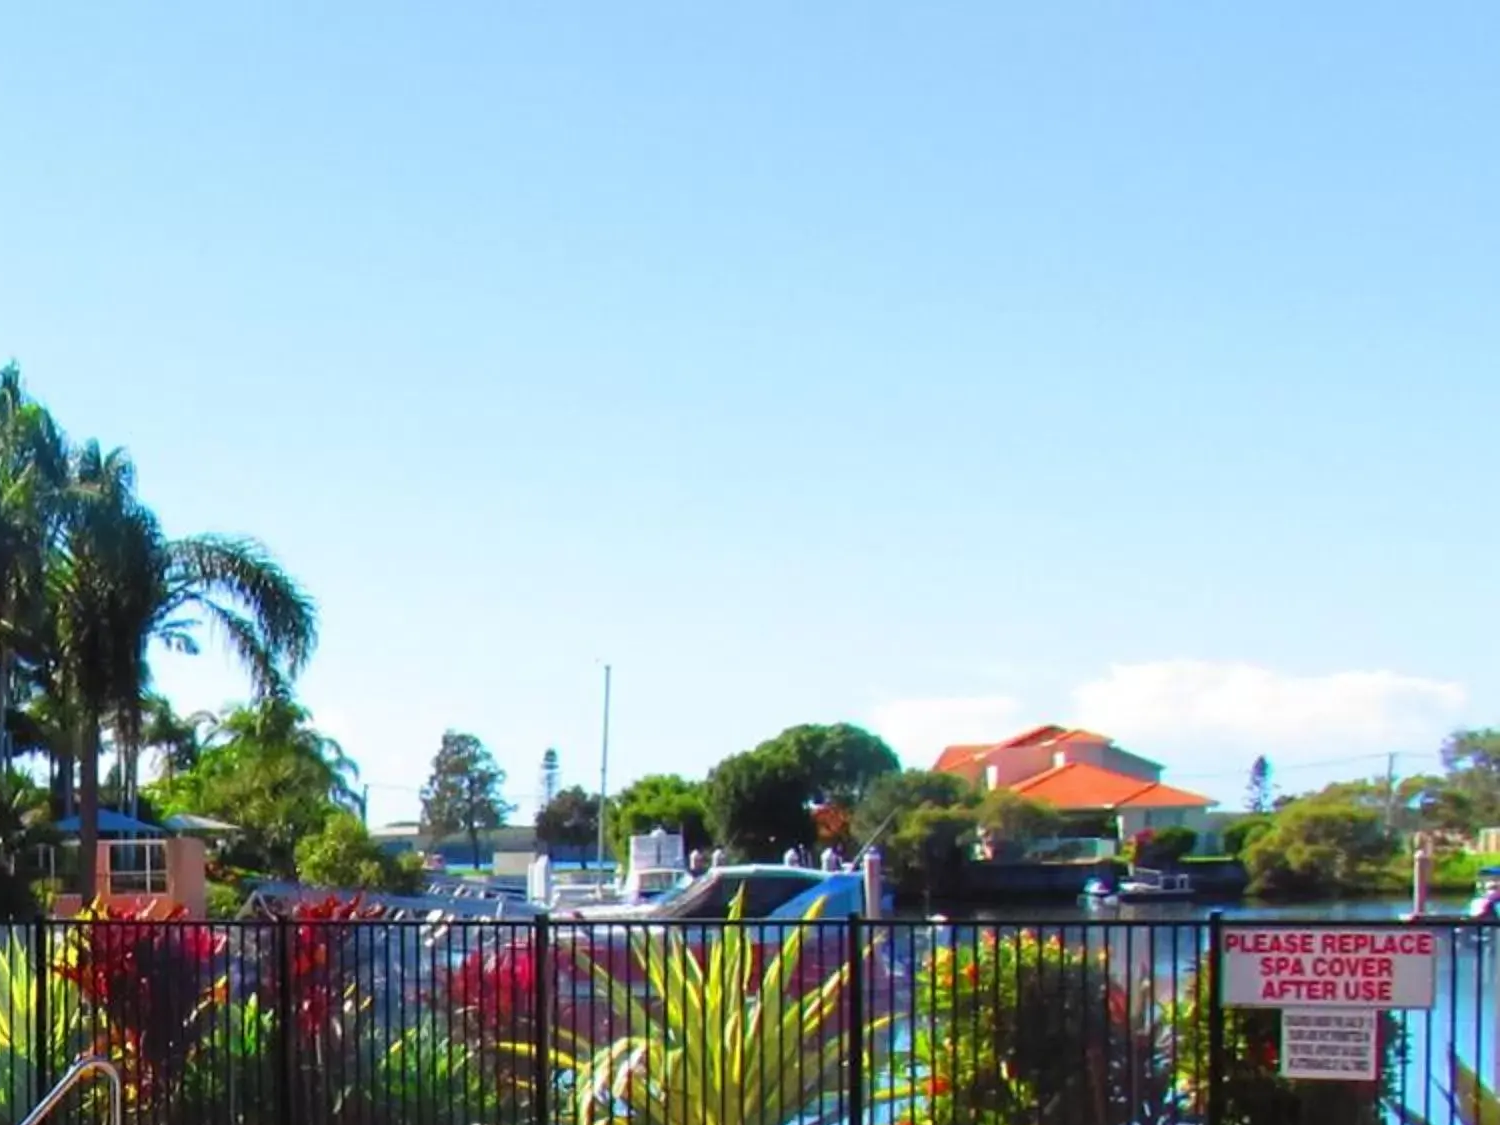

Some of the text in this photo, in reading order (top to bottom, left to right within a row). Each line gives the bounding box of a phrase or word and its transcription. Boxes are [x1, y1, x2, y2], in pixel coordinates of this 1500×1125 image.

[1224, 934, 1432, 955] PLEASE REPLACE
[1260, 957, 1392, 977] SPA COVER
[1262, 980, 1392, 1001] AFTER USE
